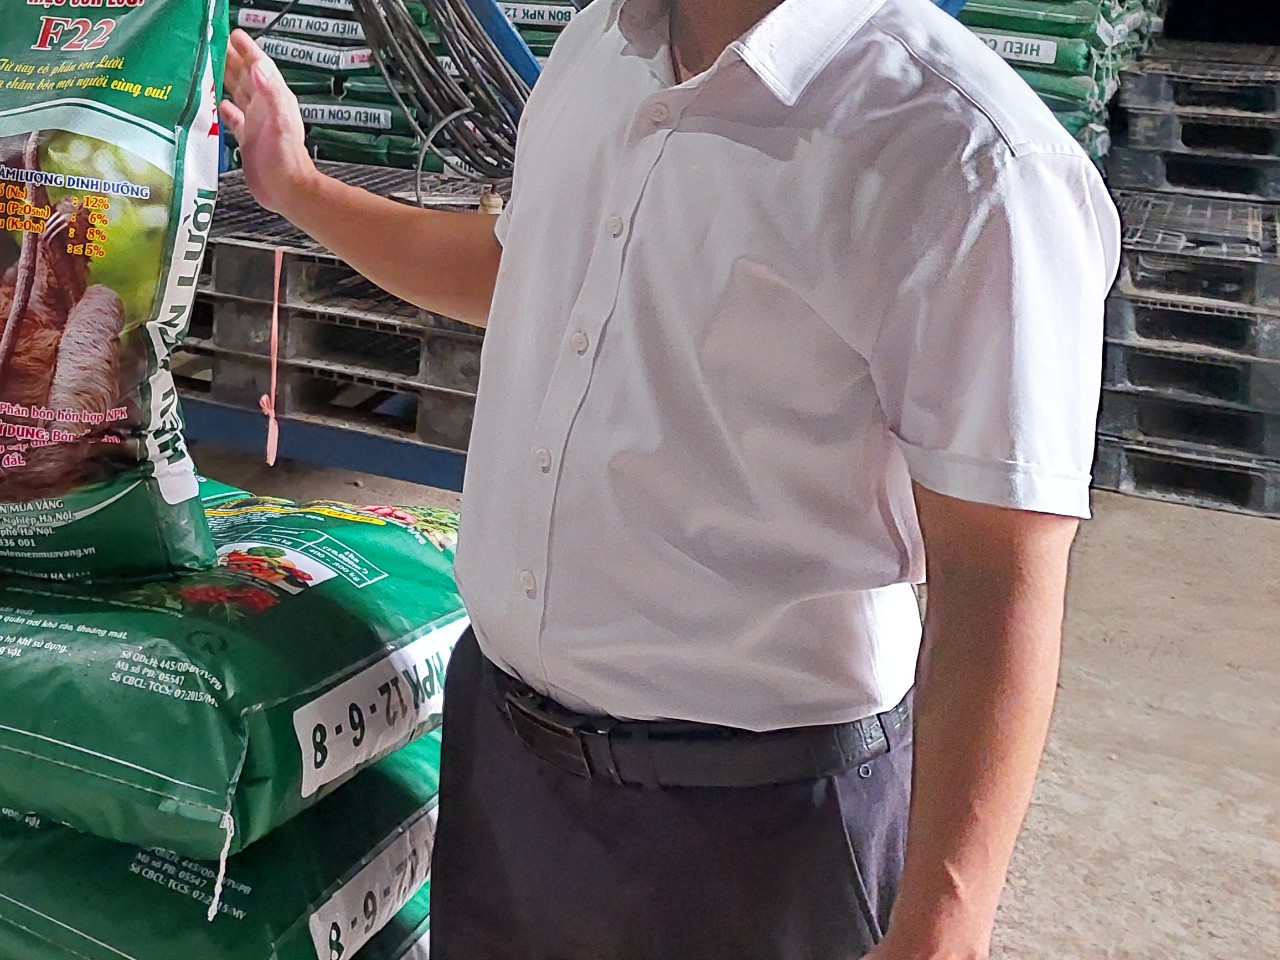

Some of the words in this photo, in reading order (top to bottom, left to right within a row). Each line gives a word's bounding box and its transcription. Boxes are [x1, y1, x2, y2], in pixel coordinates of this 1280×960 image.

[31, 16, 116, 50] F22
[305, 20, 329, 32] CON
[263, 42, 288, 56] HIỆU
[291, 48, 313, 62] CON
[14, 63, 35, 76] nay
[77, 61, 94, 71] con
[111, 78, 142, 97] cùng
[328, 109, 351, 121] CON
[18, 168, 64, 186] LƯỢNG
[66, 176, 101, 191] DINH
[101, 181, 150, 198] DƯỠNG
[83, 196, 110, 210] 12%
[89, 213, 108, 226] 6%
[87, 228, 106, 242] 8%
[177, 187, 218, 288] LƯỜI
[85, 243, 105, 257] 5%
[0, 402, 29, 417] Phân
[32, 406, 53, 420] bón
[82, 411, 104, 426] hợp
[106, 407, 127, 421] NPK
[36, 497, 65, 511] VÀNG
[17, 538, 37, 548] 001
[158, 672, 185, 686] 05547
